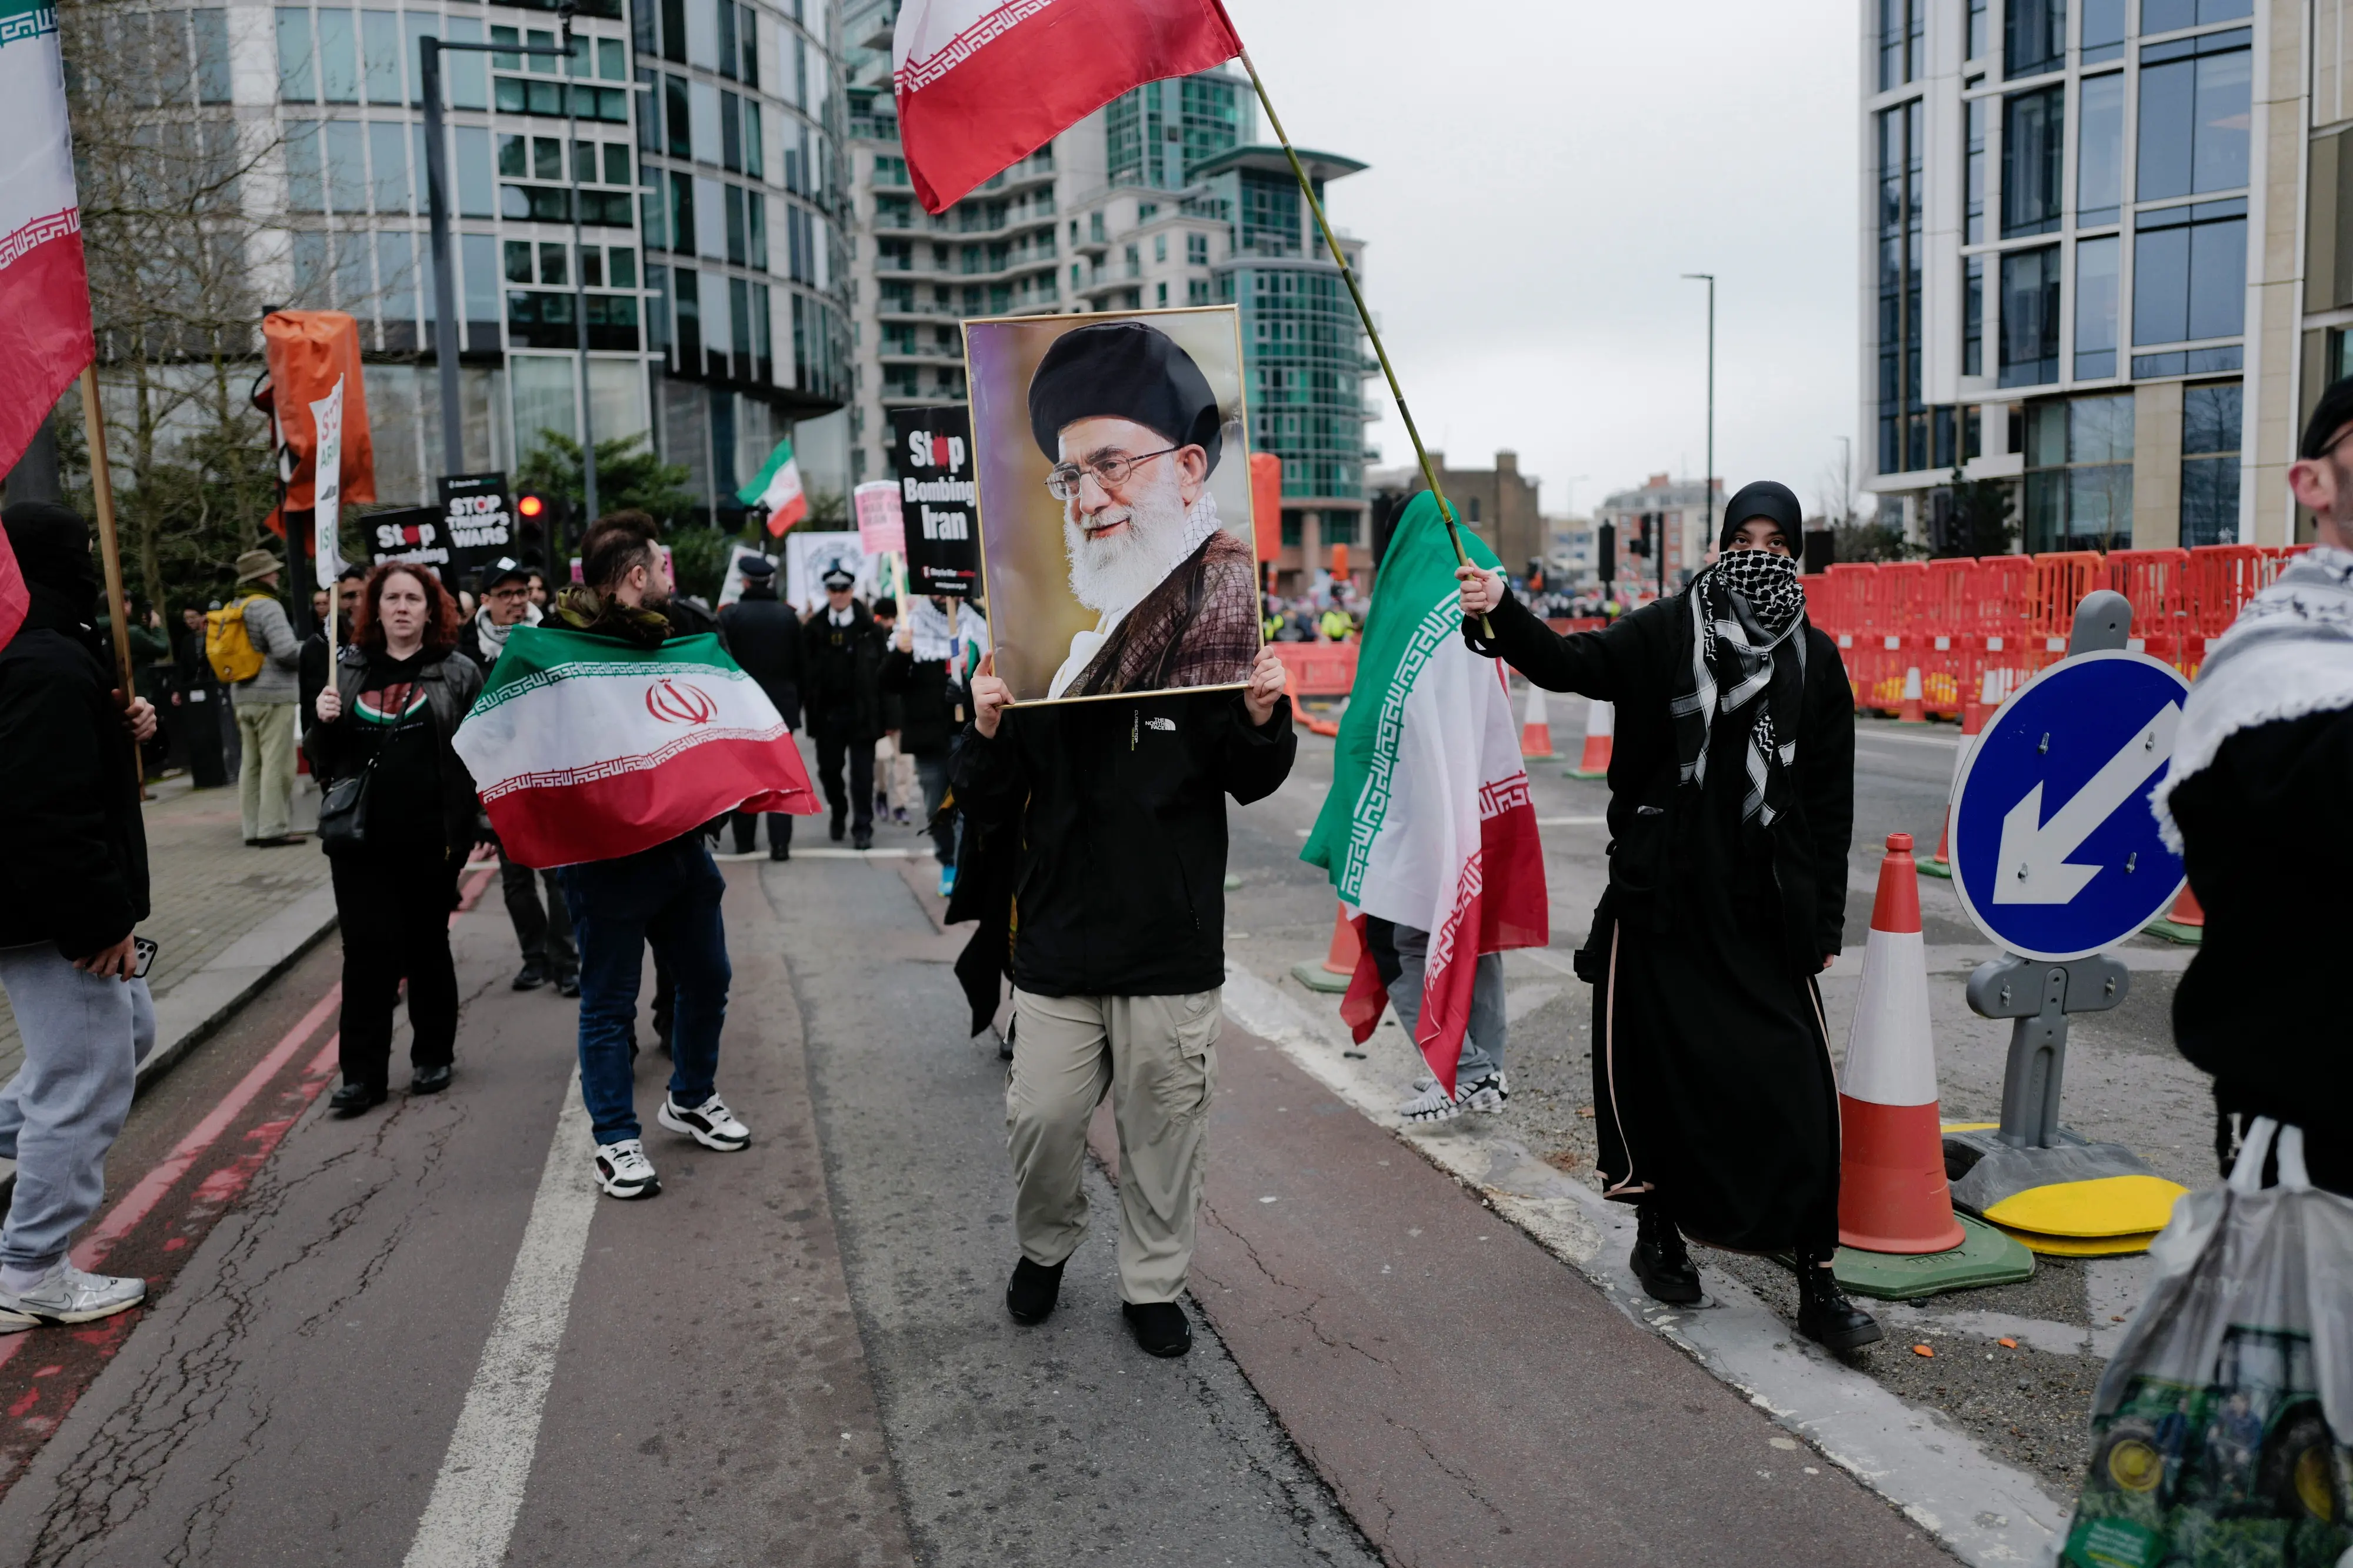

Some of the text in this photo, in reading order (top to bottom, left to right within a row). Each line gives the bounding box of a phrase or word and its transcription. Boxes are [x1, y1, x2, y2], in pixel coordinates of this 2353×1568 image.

[904, 476, 976, 507] Bombing
[449, 494, 501, 516] STOP
[921, 505, 968, 540] Iran
[450, 526, 509, 548] WARS
